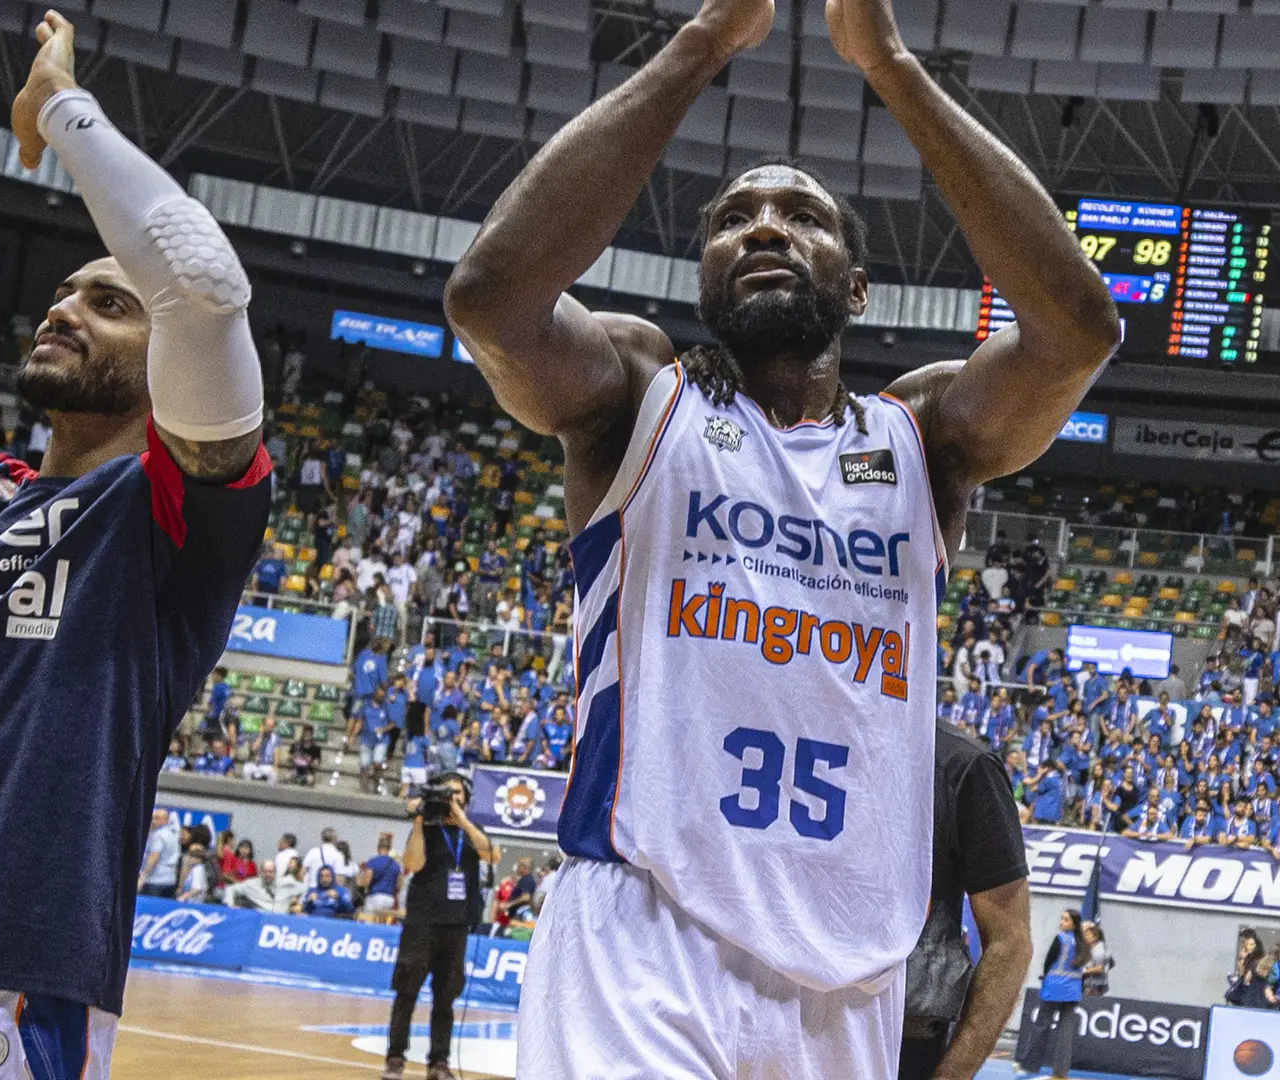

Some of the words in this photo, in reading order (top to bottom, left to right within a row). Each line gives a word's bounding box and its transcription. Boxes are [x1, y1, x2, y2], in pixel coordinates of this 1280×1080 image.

[1080, 234, 1118, 261] 97
[1132, 238, 1172, 266] 98
[845, 460, 870, 474] liga
[846, 465, 896, 483] endesa
[719, 725, 850, 842] 35
[258, 925, 328, 955] Diario
[331, 932, 361, 960] de
